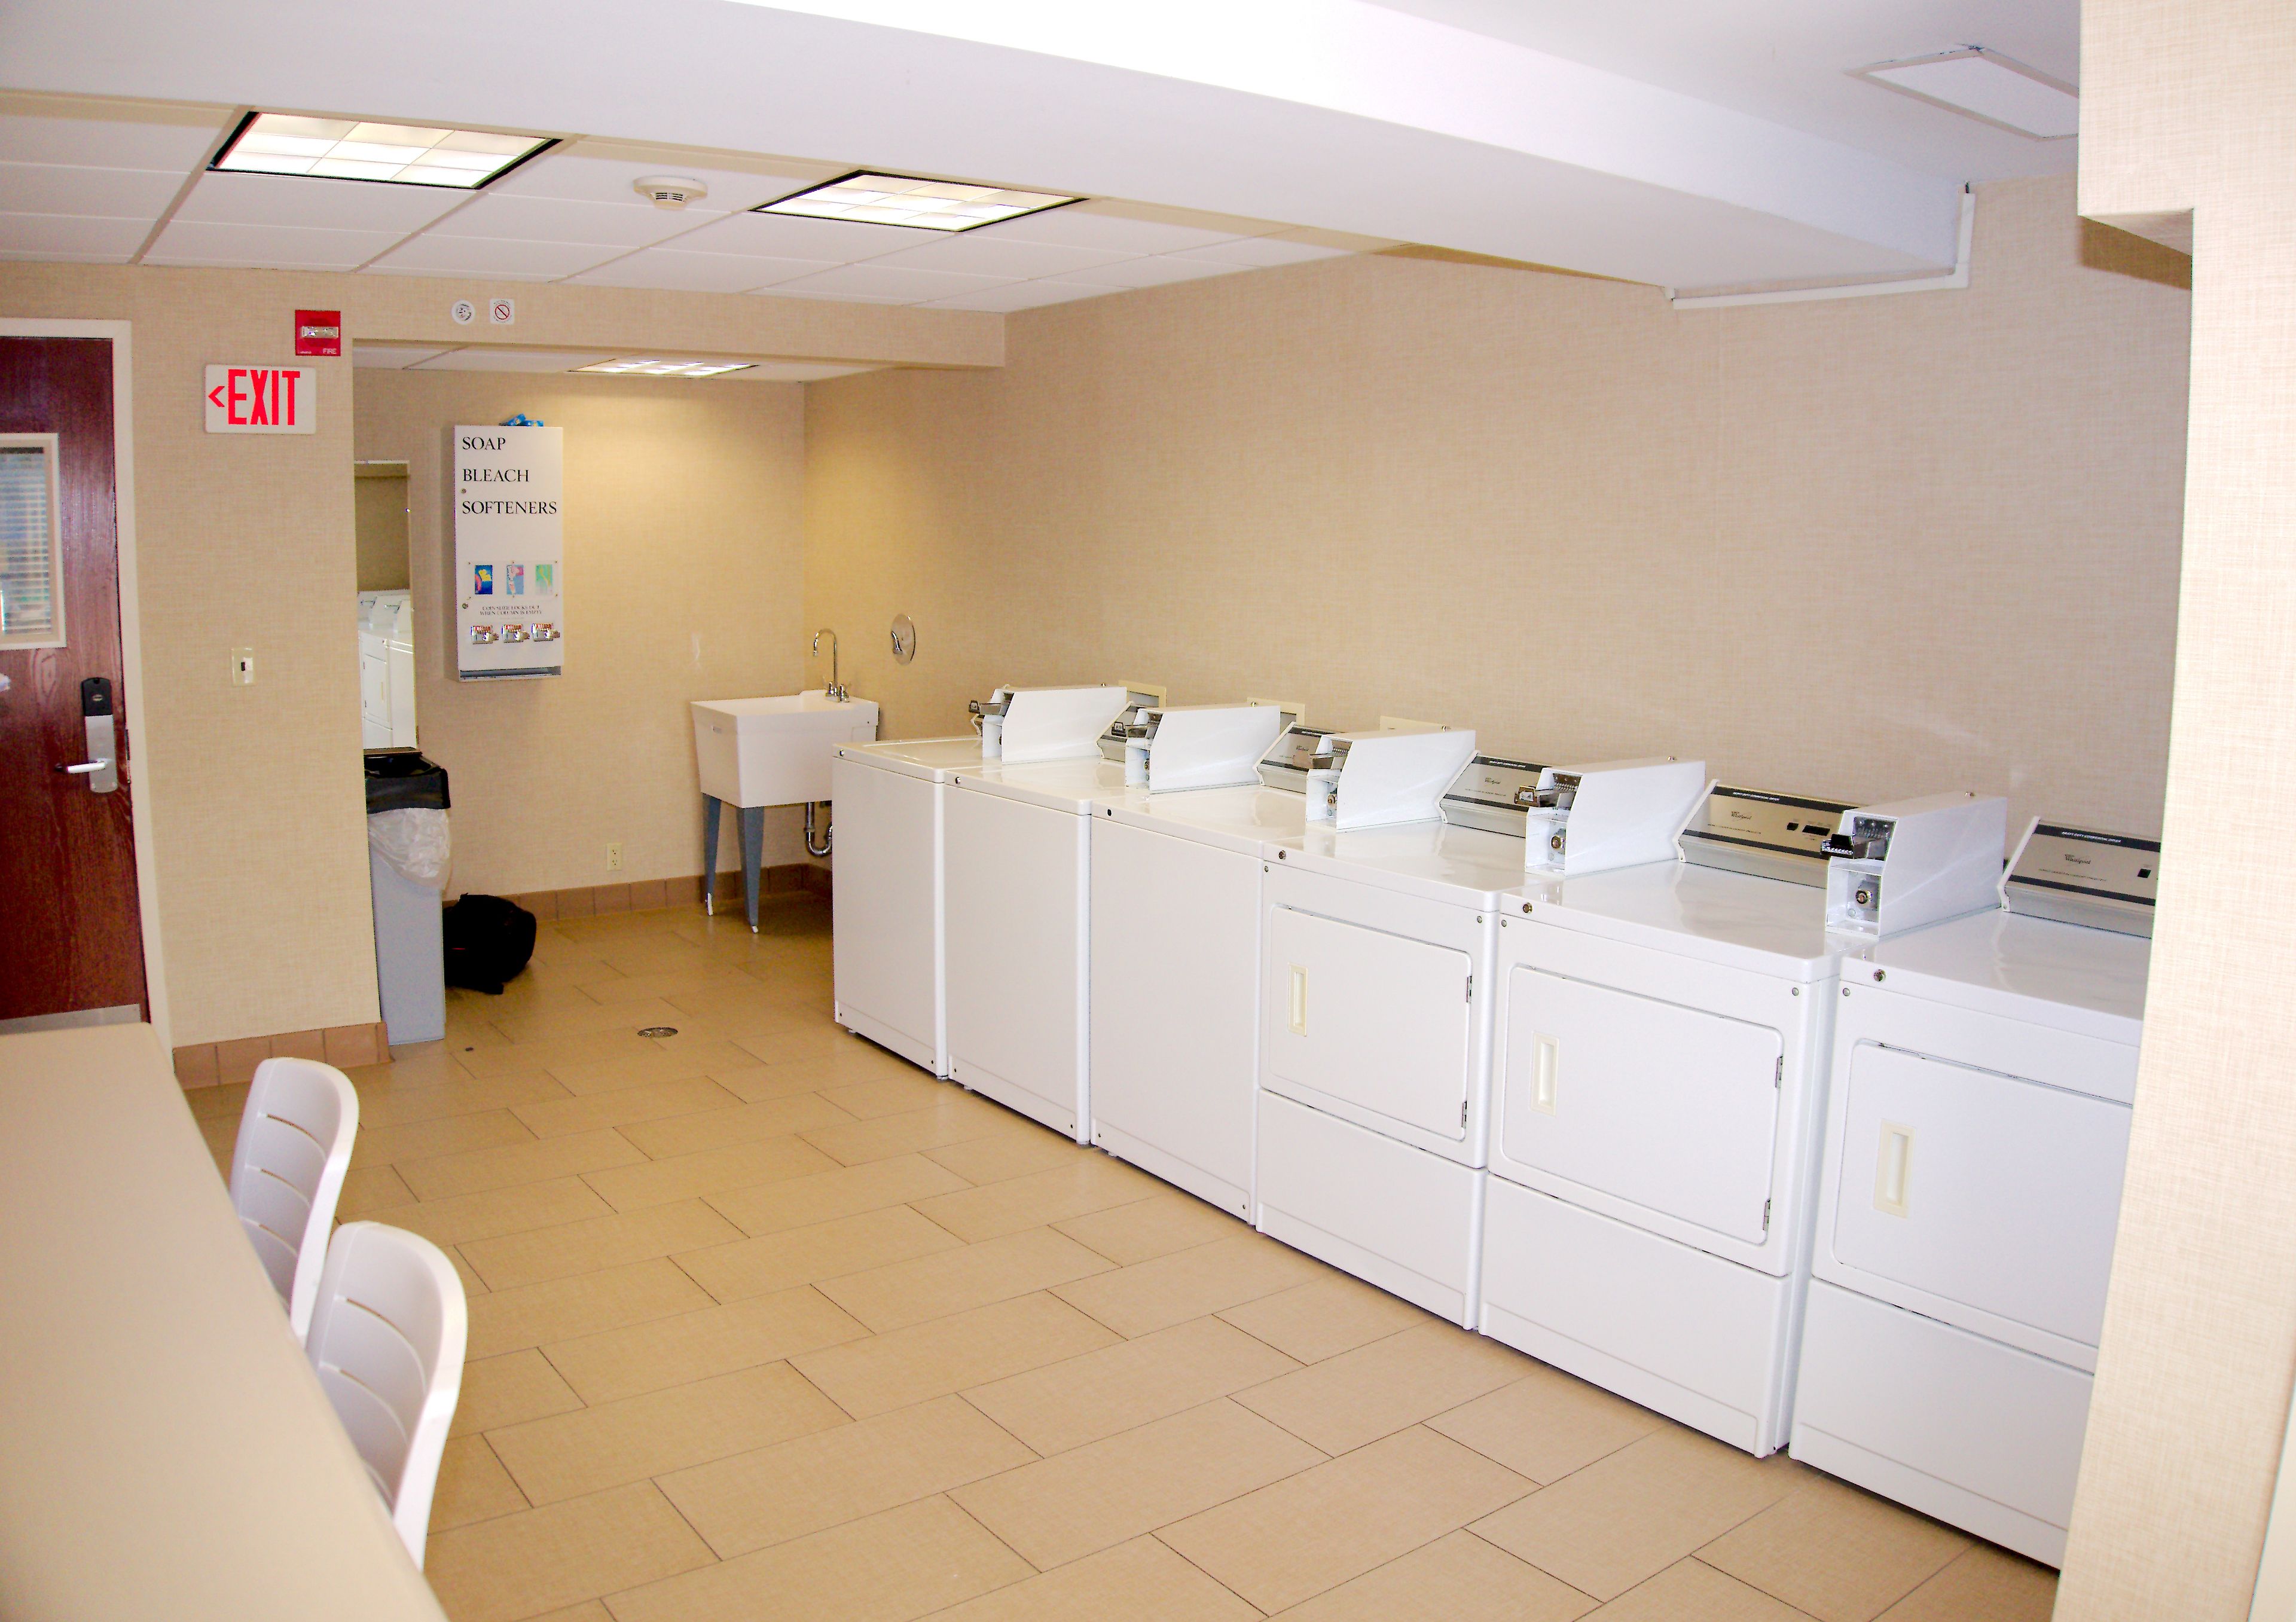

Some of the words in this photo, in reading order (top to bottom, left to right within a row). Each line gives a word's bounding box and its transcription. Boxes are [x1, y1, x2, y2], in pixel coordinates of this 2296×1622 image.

[228, 369, 301, 425] EXIT
[462, 436, 506, 450] SOAP
[463, 469, 529, 482] BLEACH
[462, 500, 557, 514] SOFTENERS
